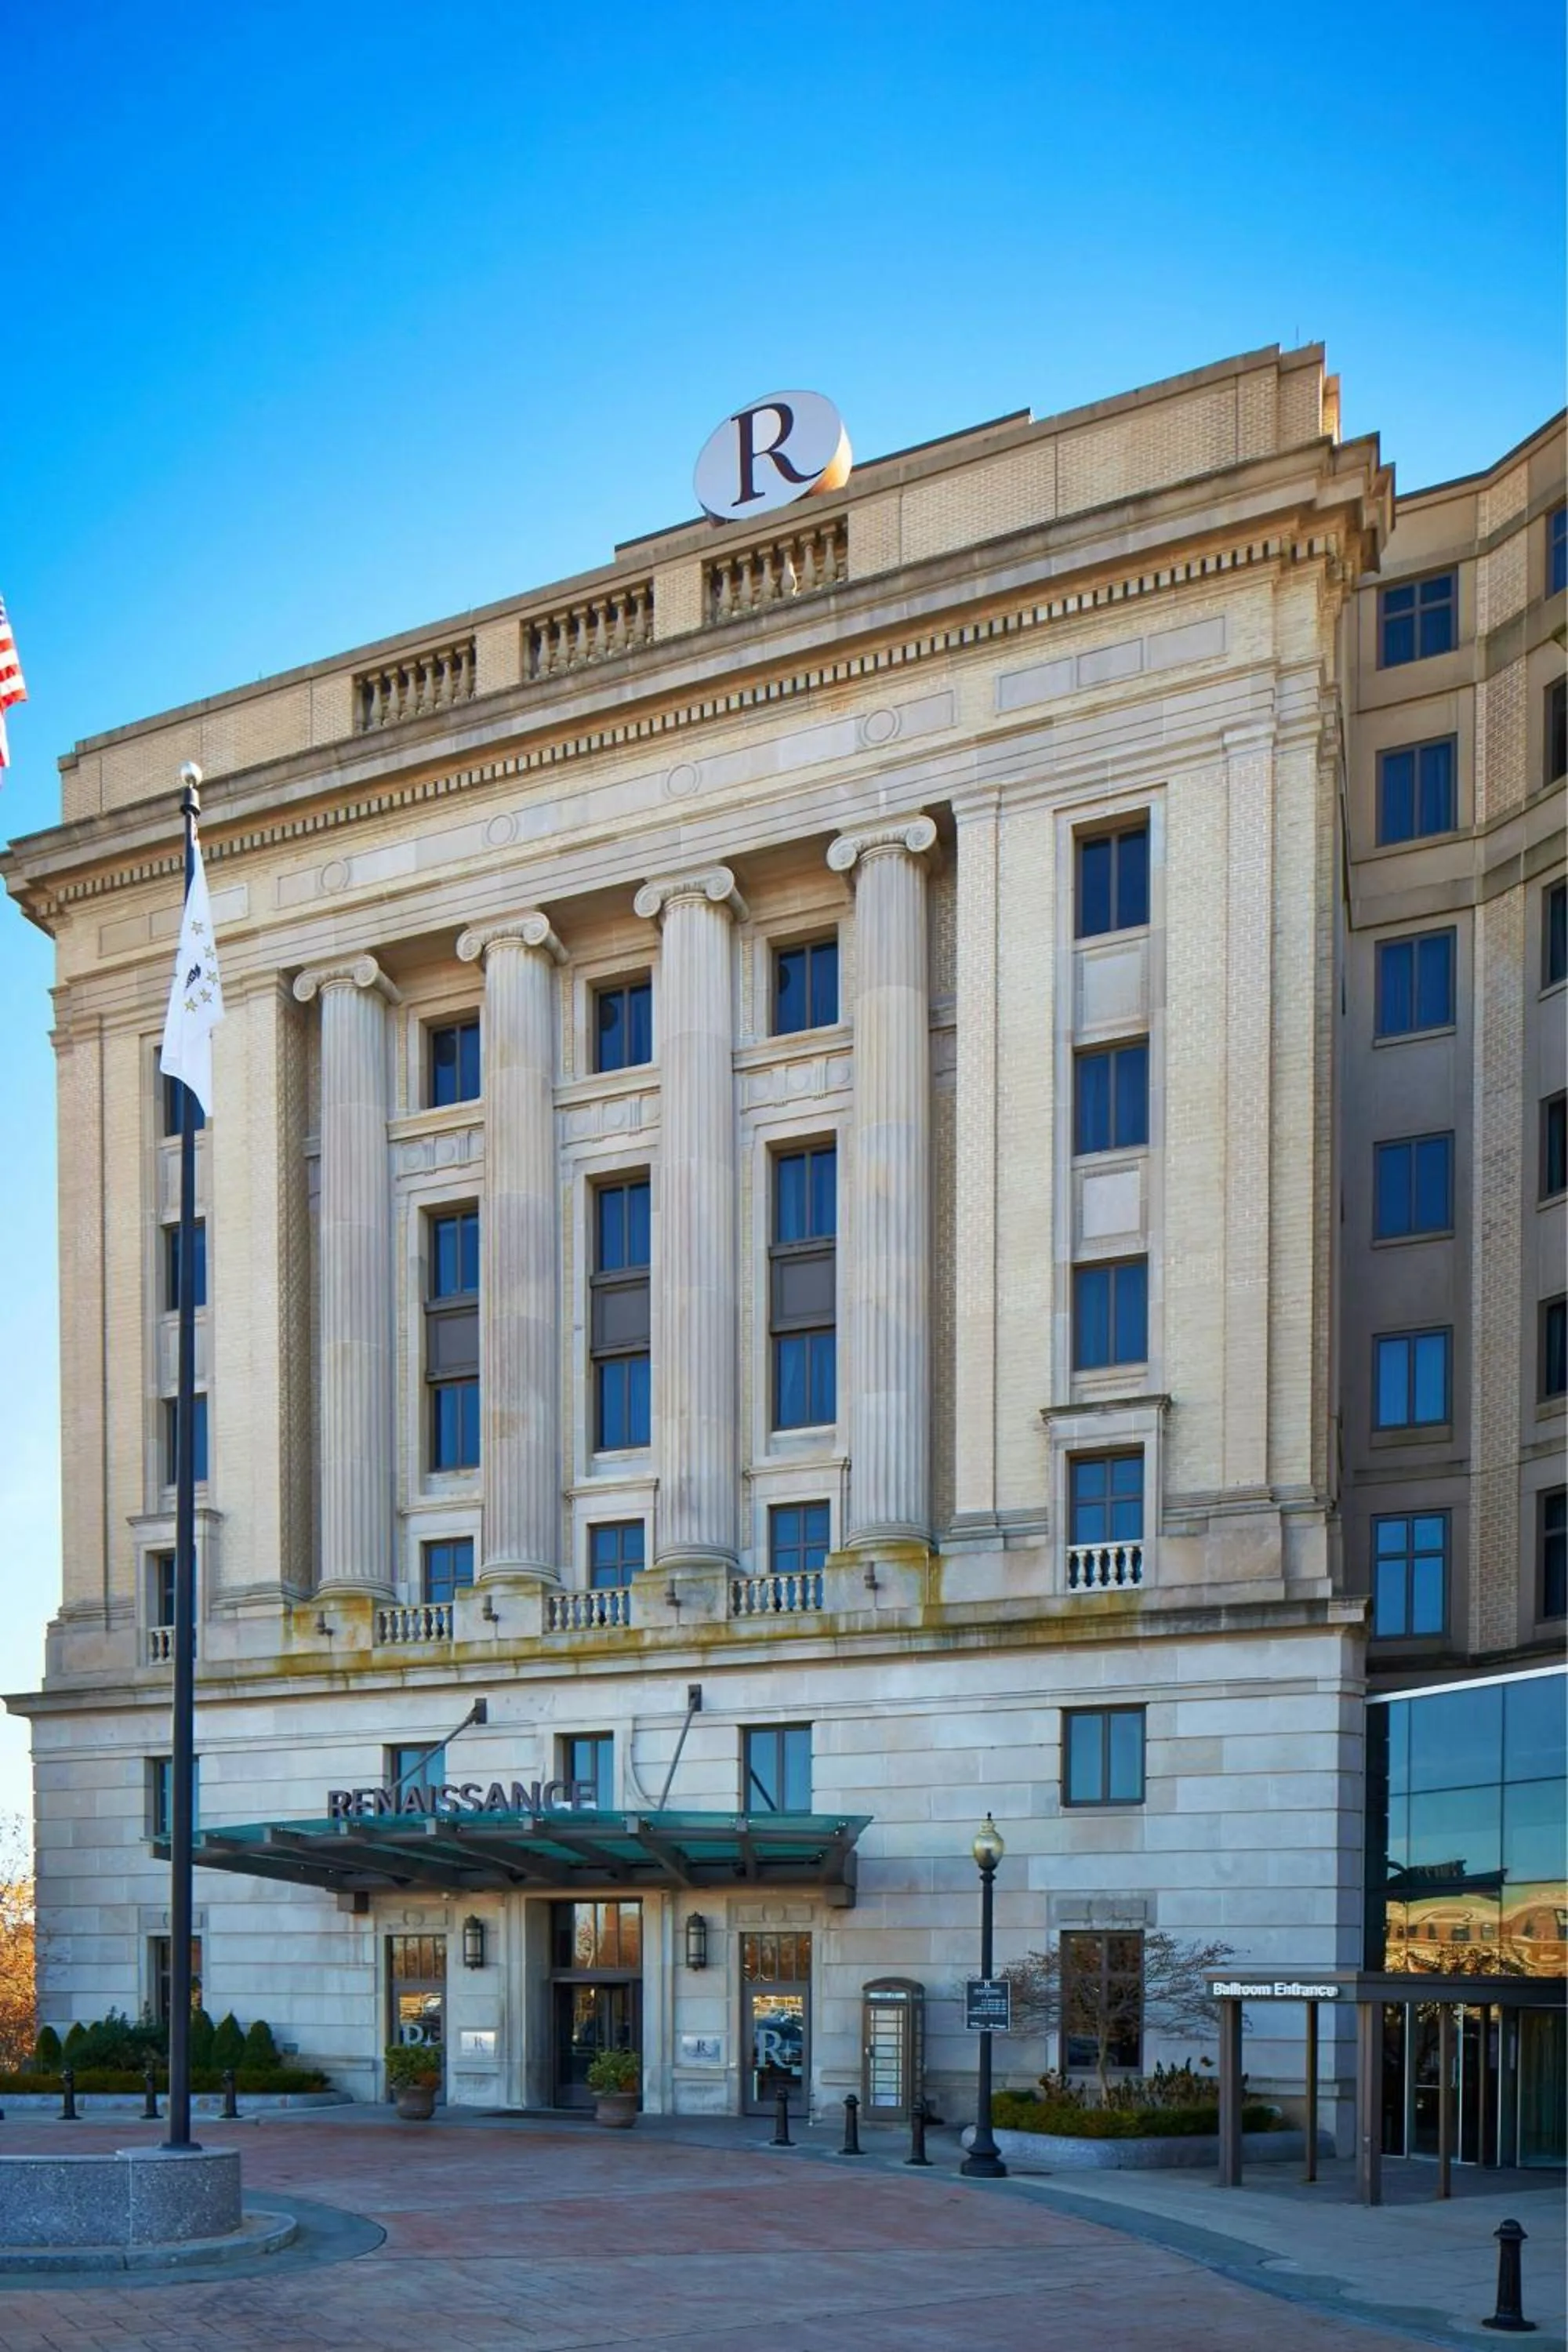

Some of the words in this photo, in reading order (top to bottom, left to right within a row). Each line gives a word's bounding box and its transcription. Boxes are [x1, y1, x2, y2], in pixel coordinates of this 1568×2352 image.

[730, 402, 826, 507] R
[328, 1780, 598, 1819] RENAISSANCE
[1213, 1982, 1271, 1995] Ballroom
[1274, 1982, 1338, 1997] Entrance
[755, 2029, 795, 2068] R
